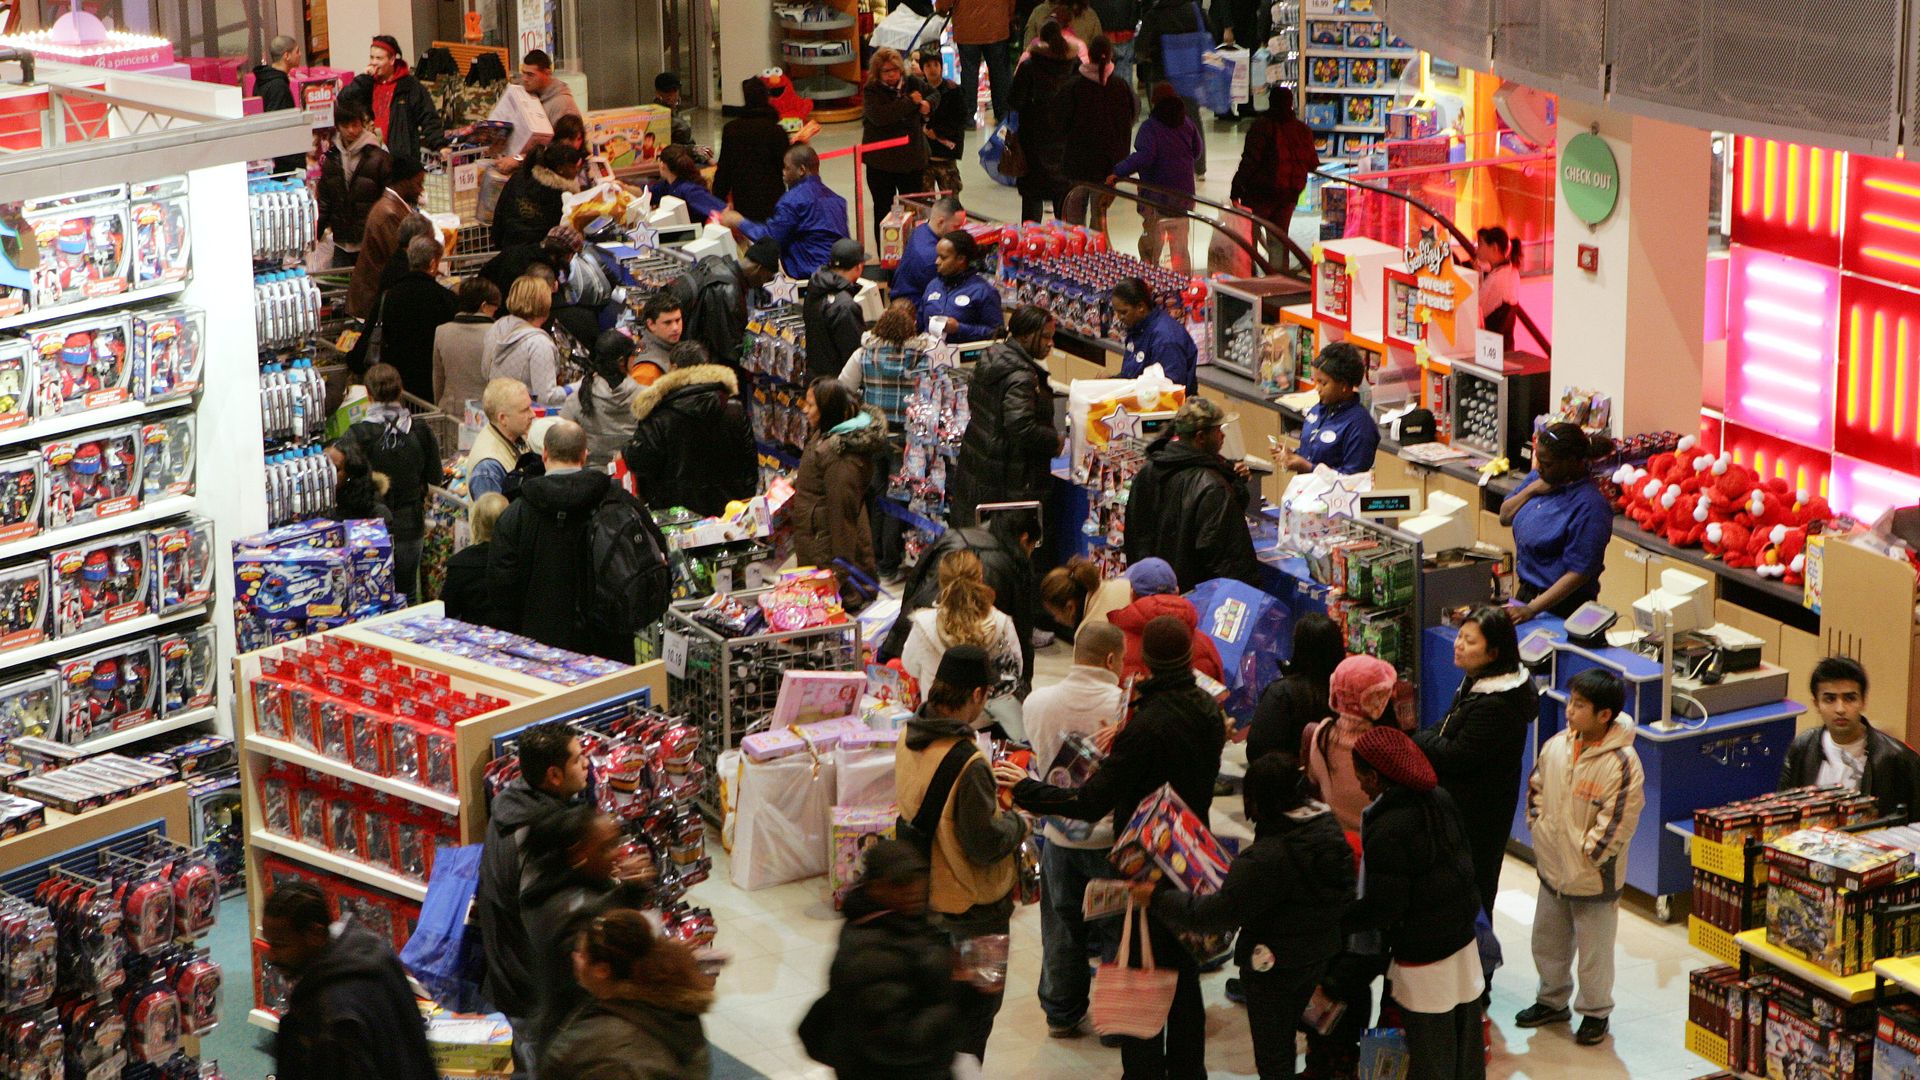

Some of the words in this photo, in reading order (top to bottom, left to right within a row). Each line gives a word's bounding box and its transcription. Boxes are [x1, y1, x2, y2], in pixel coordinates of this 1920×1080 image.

[114, 57, 149, 70] princess
[308, 87, 331, 101] sale
[1564, 165, 1592, 185] CHECK
[1593, 171, 1612, 190] OUT
[1404, 240, 1451, 276] Geoffrey's
[1417, 276, 1454, 296] sweet
[1483, 345, 1497, 361] 1.49
[667, 649, 682, 666] 10.19
